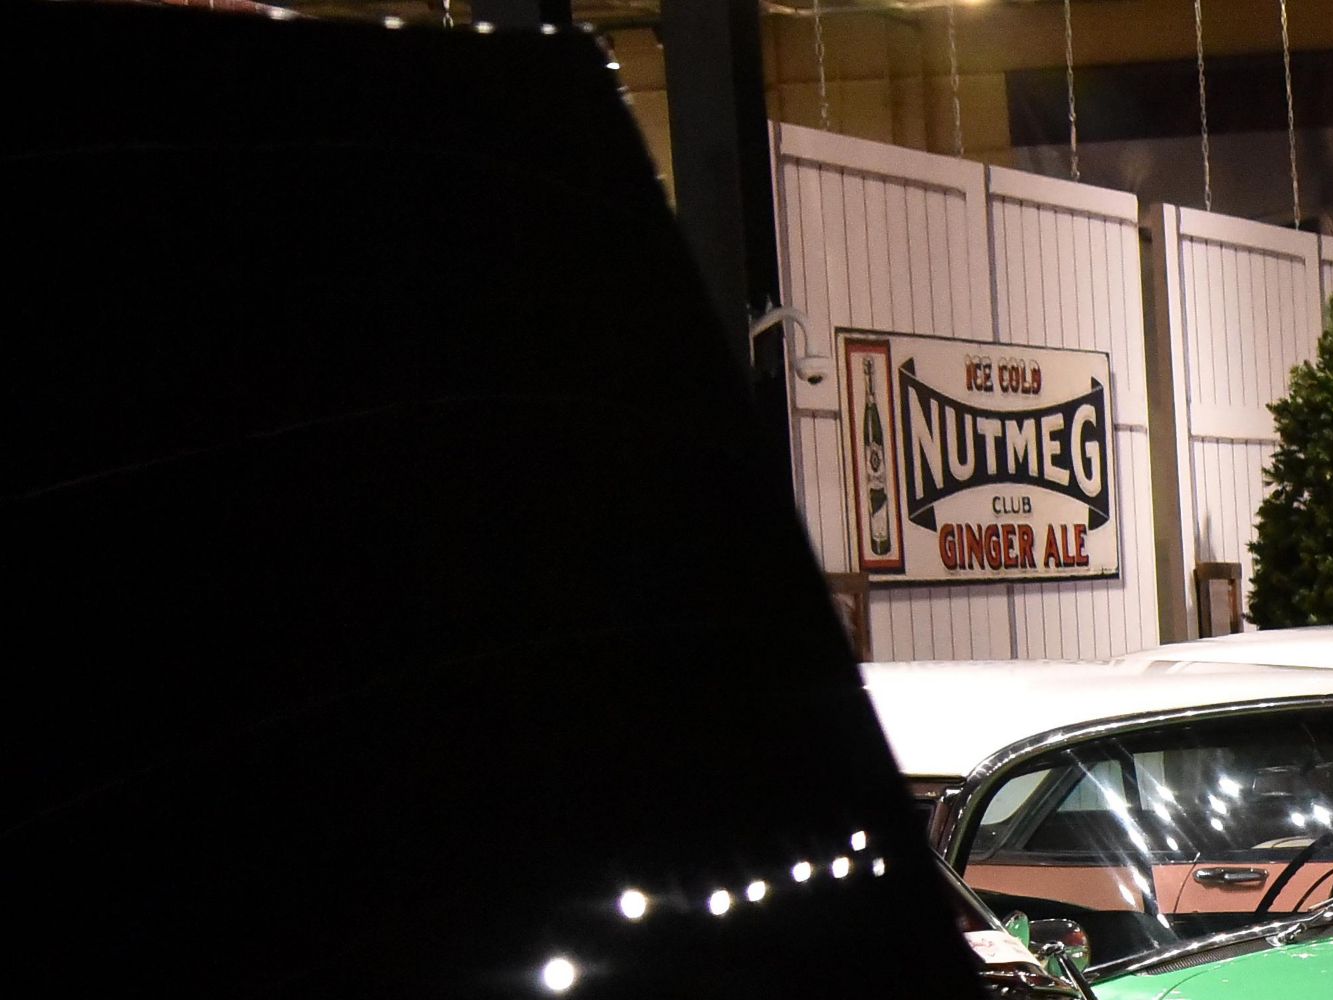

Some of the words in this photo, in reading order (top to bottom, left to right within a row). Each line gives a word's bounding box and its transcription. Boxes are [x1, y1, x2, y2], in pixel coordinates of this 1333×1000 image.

[965, 355, 993, 392] ICE
[998, 356, 1042, 395] COLD
[908, 385, 1103, 500] NUTMEG
[993, 496, 1032, 514] CLUB
[939, 523, 1037, 570] GINGER
[1043, 523, 1090, 569] ALE
